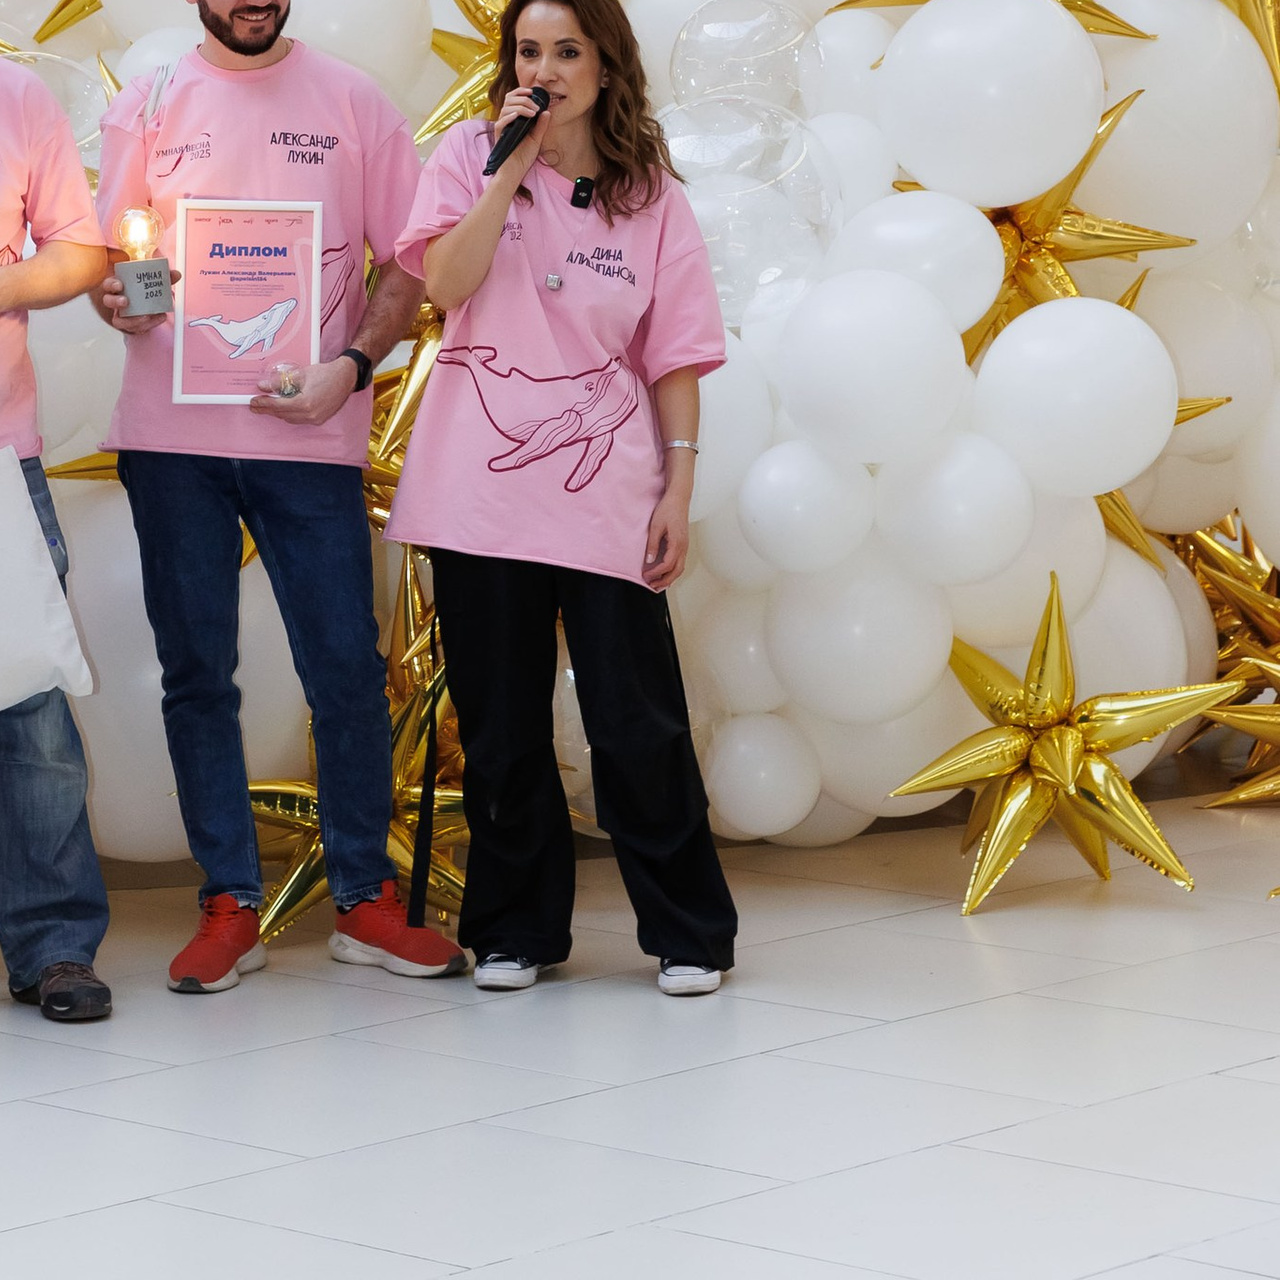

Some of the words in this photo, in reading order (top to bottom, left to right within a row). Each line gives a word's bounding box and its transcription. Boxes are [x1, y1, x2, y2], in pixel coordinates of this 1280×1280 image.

[270, 131, 339, 150] АЛЕКСАНДР
[190, 148, 212, 161] 2025
[287, 149, 324, 165] ЛУКИН
[209, 243, 288, 259] Диплом
[590, 247, 623, 262] ДИНА
[136, 270, 163, 284] УМНАЯ
[144, 289, 163, 300] 2025
